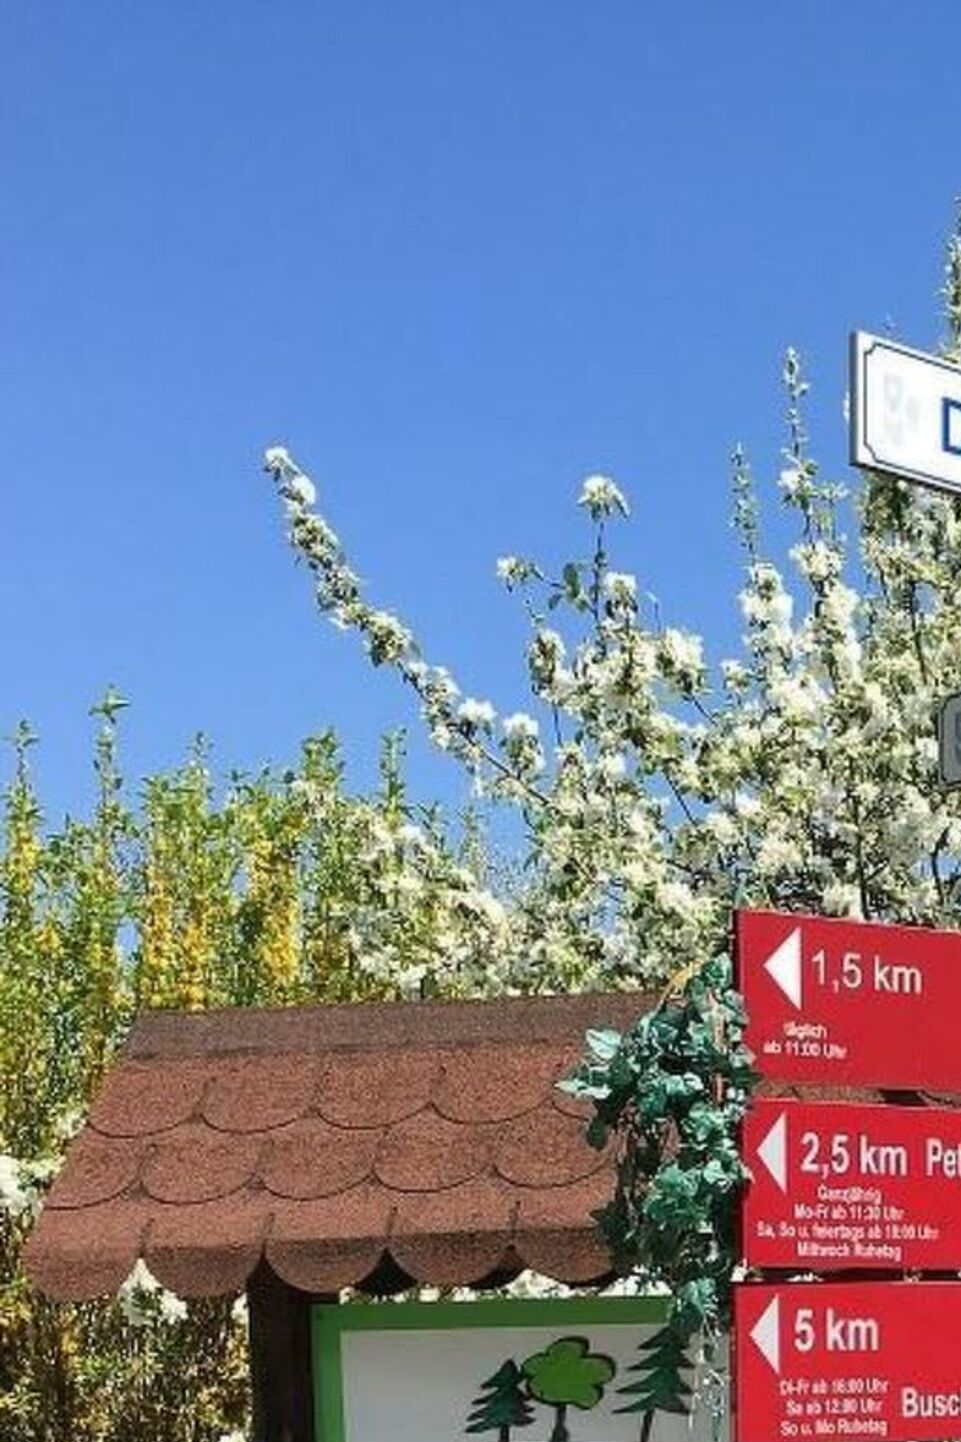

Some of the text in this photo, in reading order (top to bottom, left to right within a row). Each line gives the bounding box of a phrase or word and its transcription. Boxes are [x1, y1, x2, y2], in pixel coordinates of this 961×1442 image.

[811, 949, 923, 994] 1,5 km
[800, 1131, 908, 1179] 2,5 km
[794, 1306, 880, 1352] 5 km
